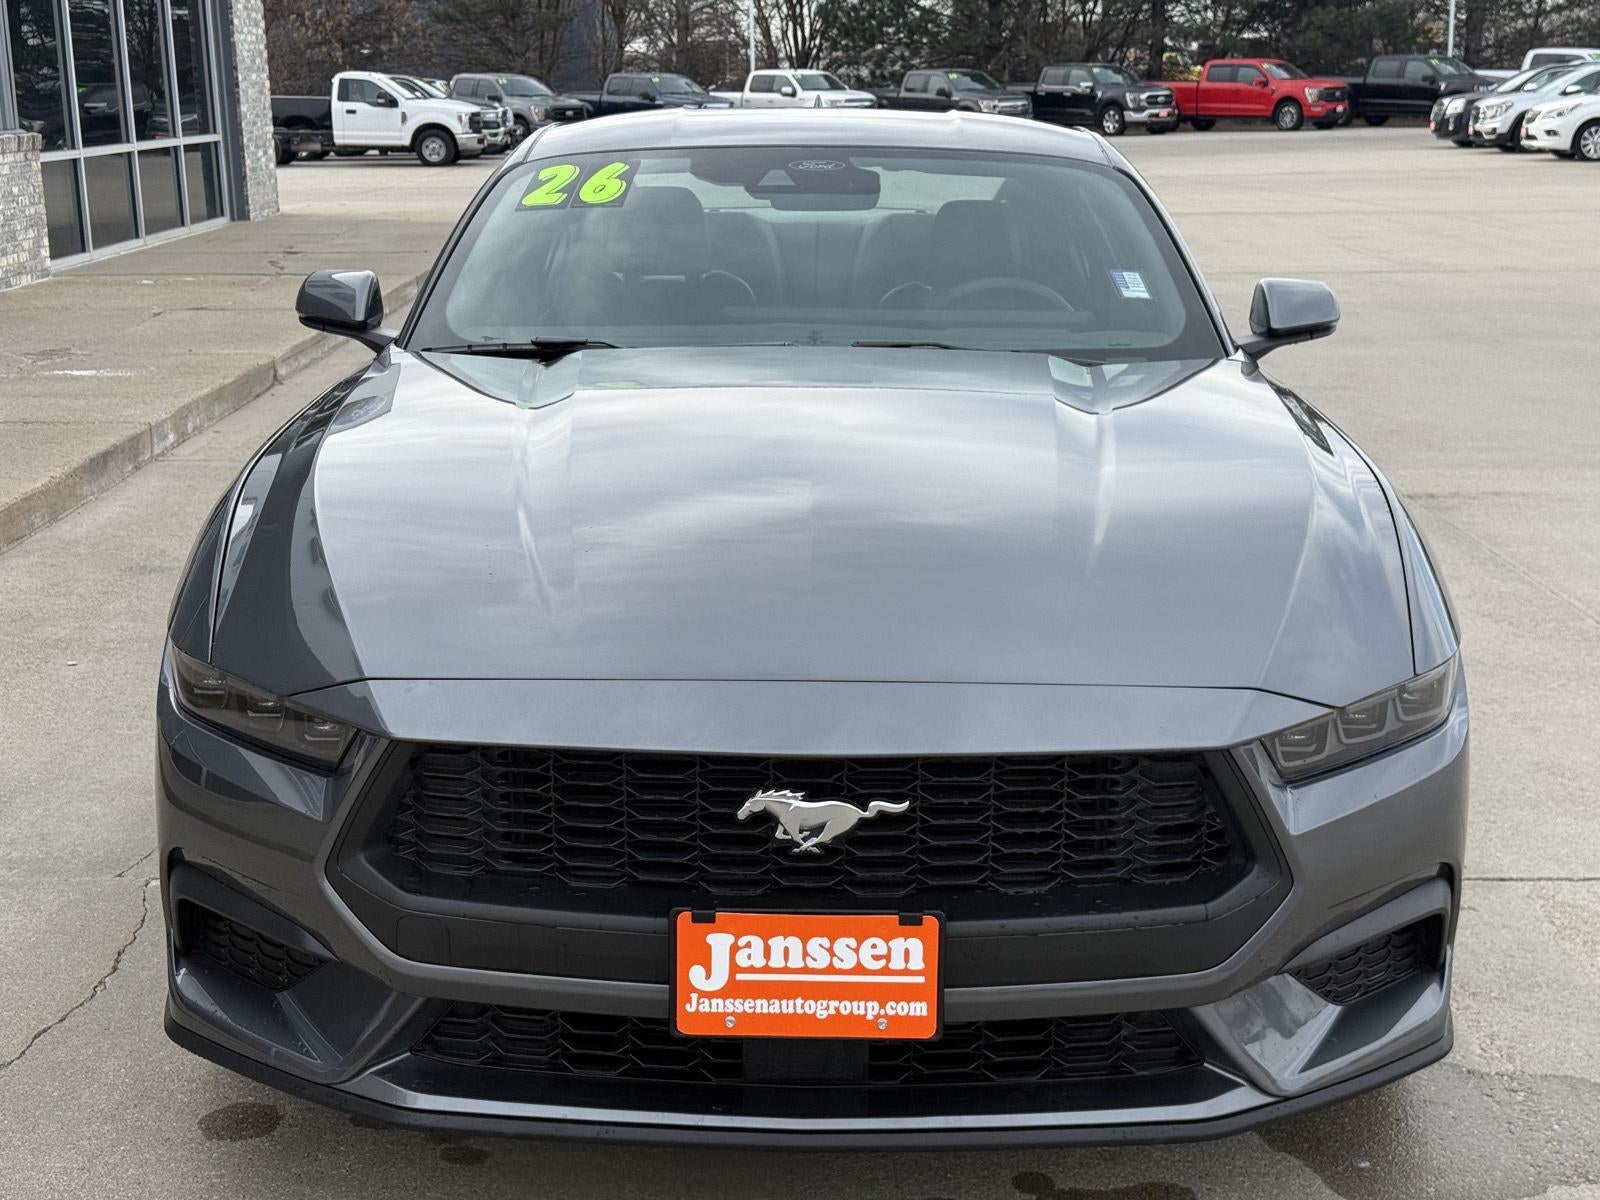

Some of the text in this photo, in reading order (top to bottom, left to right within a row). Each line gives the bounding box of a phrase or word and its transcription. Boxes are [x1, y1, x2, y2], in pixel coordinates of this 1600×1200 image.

[798, 160, 834, 170] Ford
[521, 161, 630, 206] 26
[688, 932, 926, 992] Janssen
[685, 992, 928, 1020] Janssenautogroup.com
